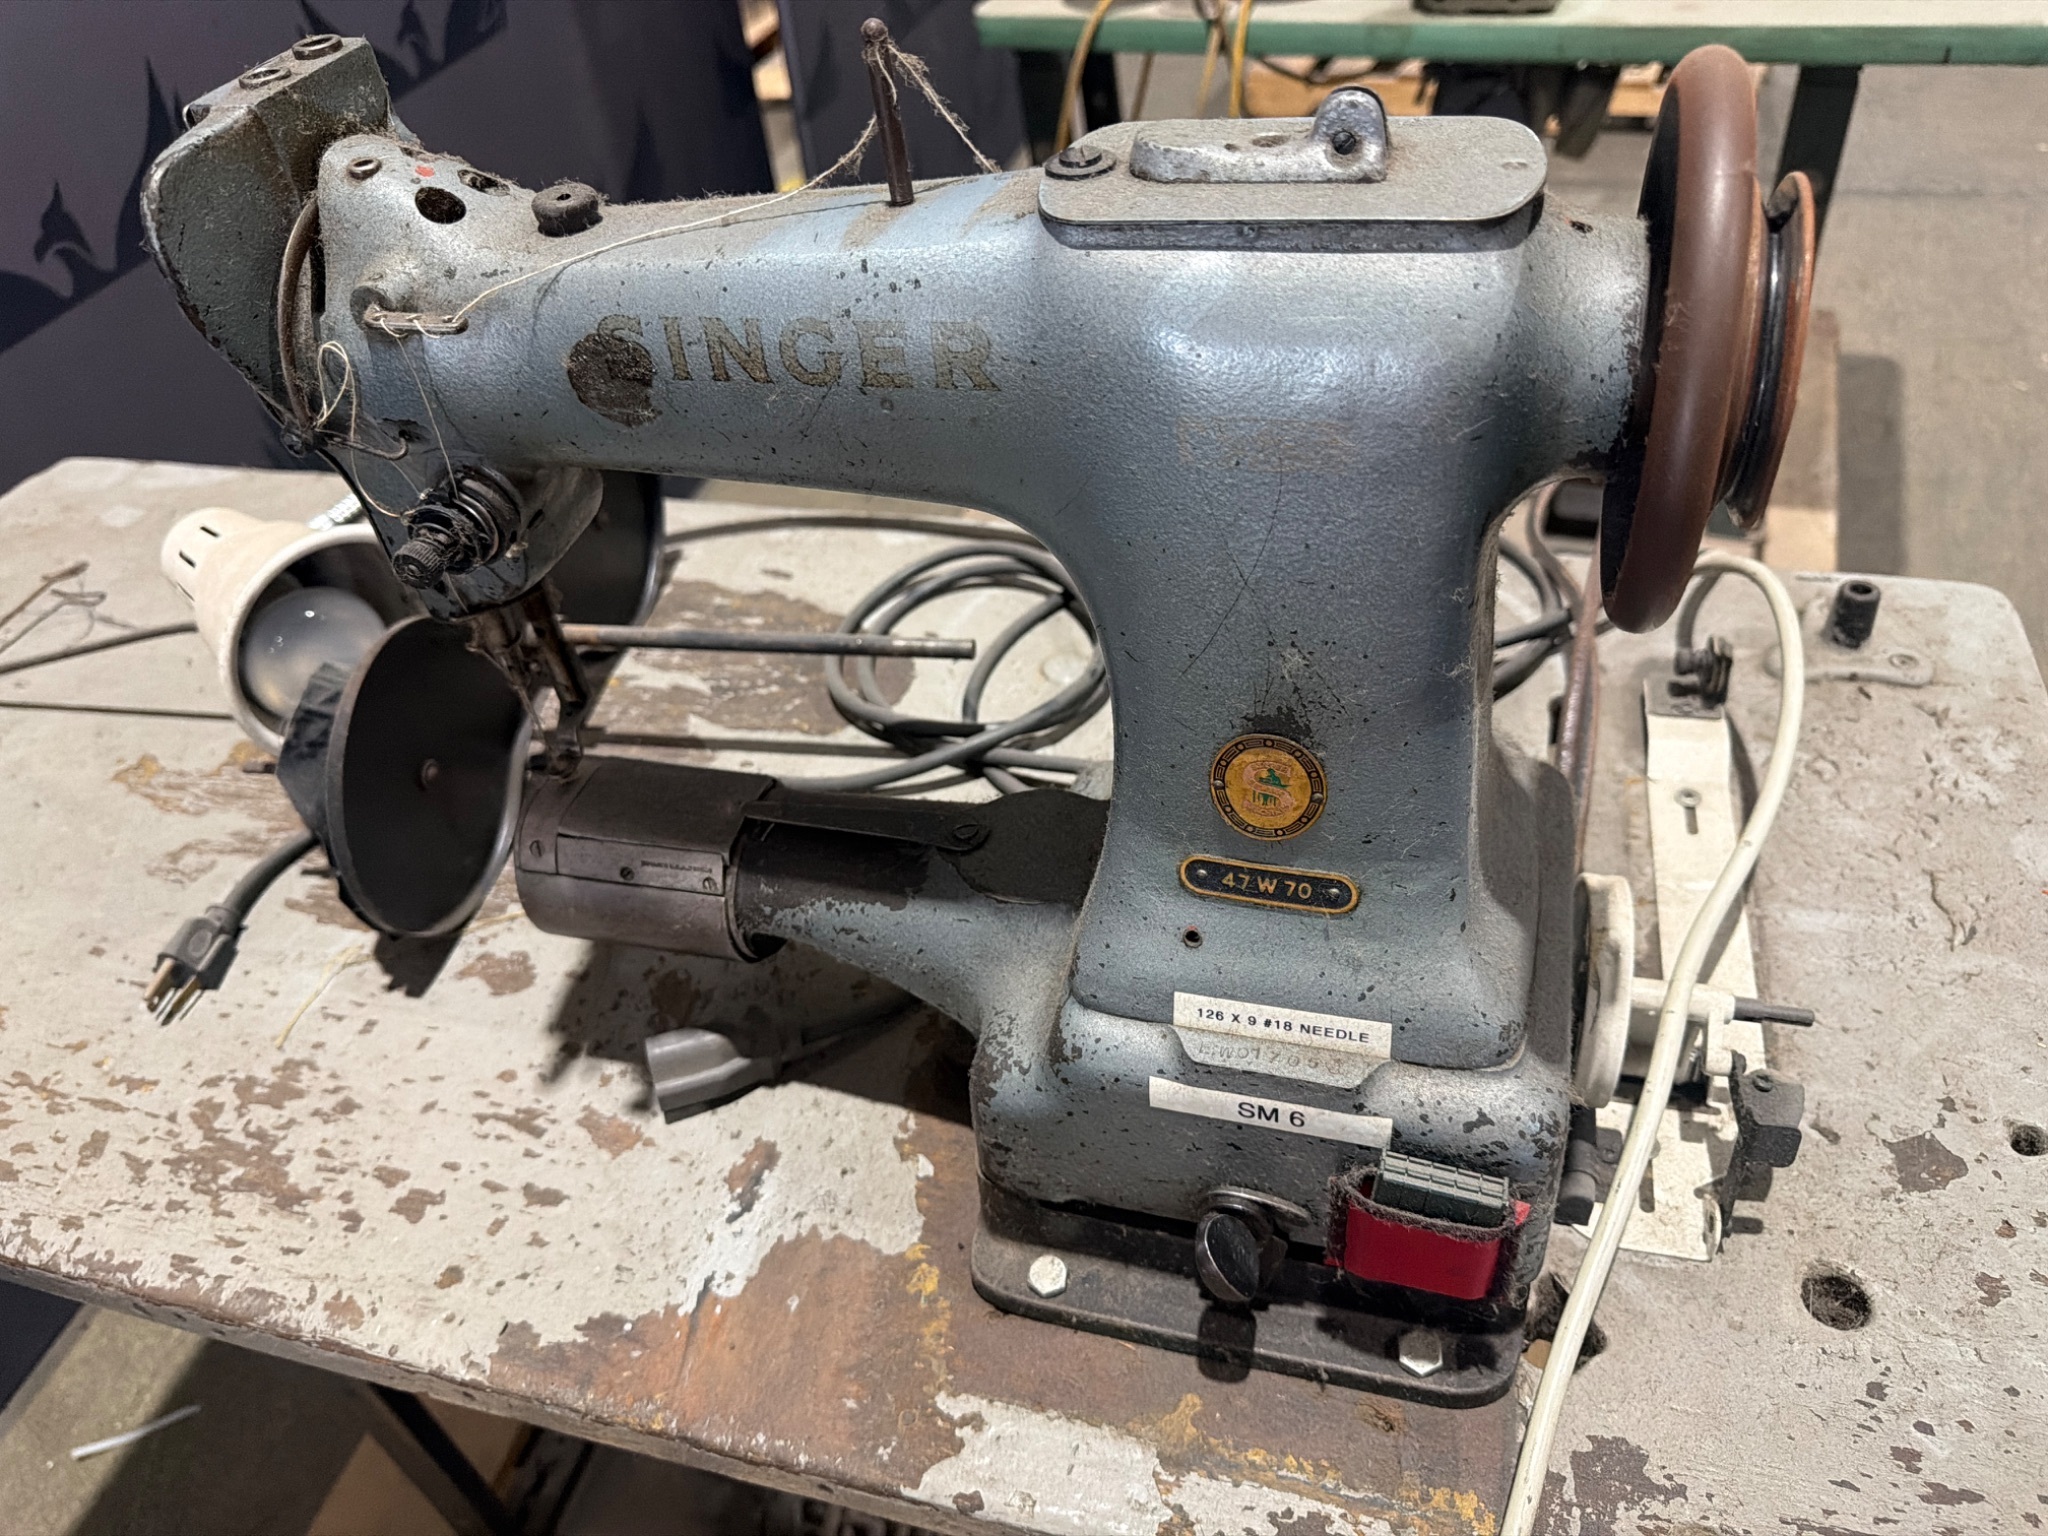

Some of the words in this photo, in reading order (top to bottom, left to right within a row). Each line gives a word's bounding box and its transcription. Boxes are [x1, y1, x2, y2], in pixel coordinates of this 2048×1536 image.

[597, 312, 1001, 392] SINGER
[1197, 1008, 1224, 1022] 126
[1231, 1013, 1240, 1024] X
[1247, 1015, 1257, 1026] 9
[1264, 1019, 1293, 1032] #18
[1300, 1023, 1370, 1044] NEEDLE
[1237, 1101, 1279, 1123] SM
[1289, 1111, 1306, 1128] 6
